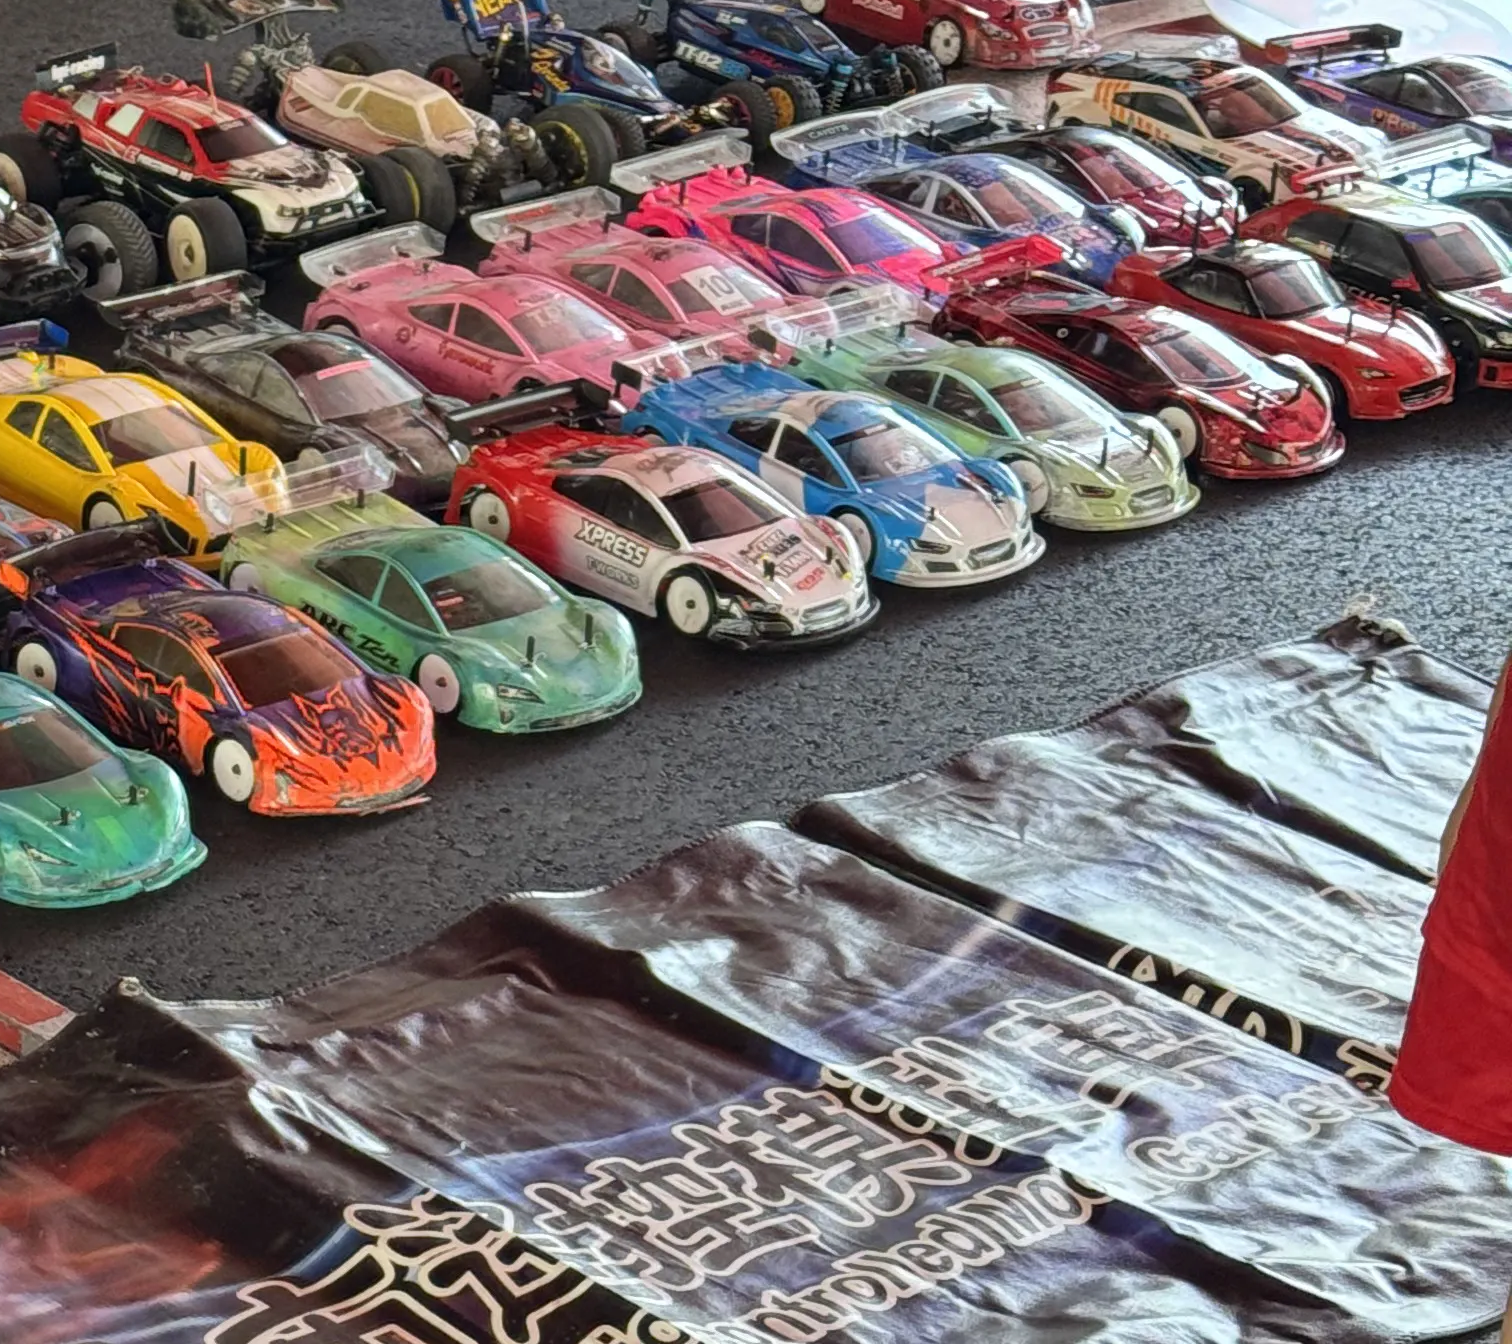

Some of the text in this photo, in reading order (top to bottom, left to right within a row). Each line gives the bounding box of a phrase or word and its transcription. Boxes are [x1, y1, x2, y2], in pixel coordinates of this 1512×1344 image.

[699, 274, 735, 298] 10
[576, 518, 649, 568] XPRESS
[300, 600, 400, 669] ARC Ten
[1128, 1121, 1275, 1182] Car
